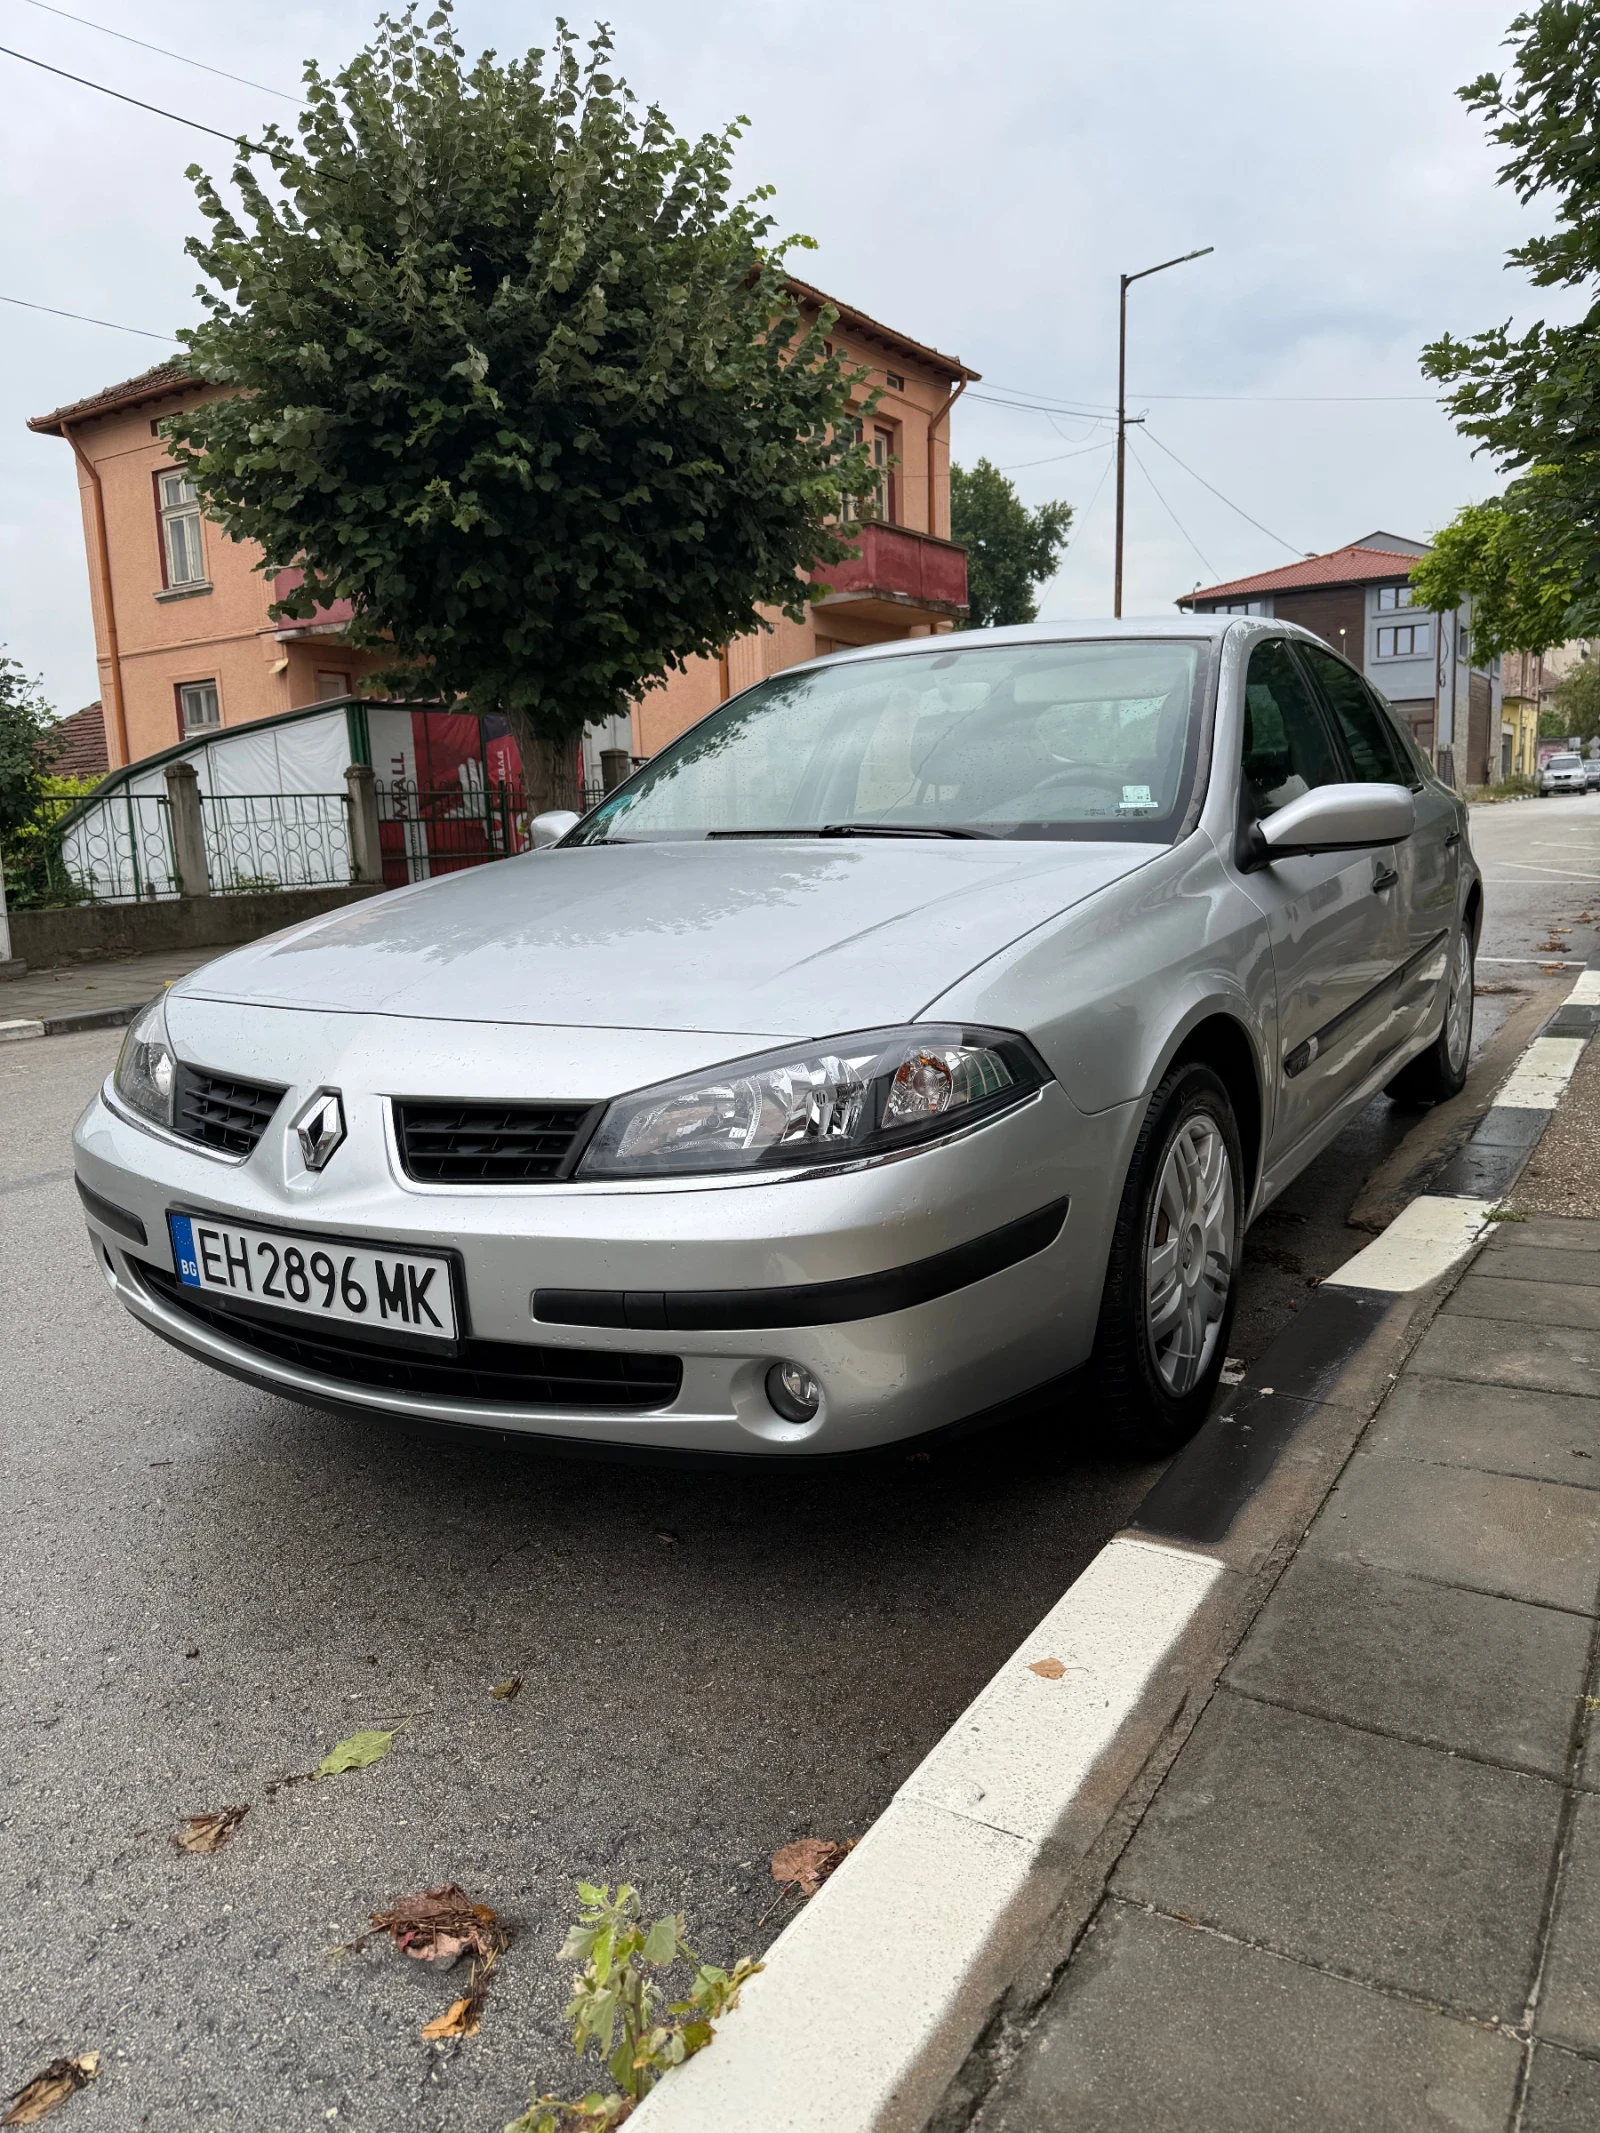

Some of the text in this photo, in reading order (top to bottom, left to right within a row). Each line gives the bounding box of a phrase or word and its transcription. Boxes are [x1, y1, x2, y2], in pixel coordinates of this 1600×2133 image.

[391, 752, 408, 819] MALL
[181, 1259, 197, 1277] BG
[198, 1228, 444, 1329] EH 2896 MK
